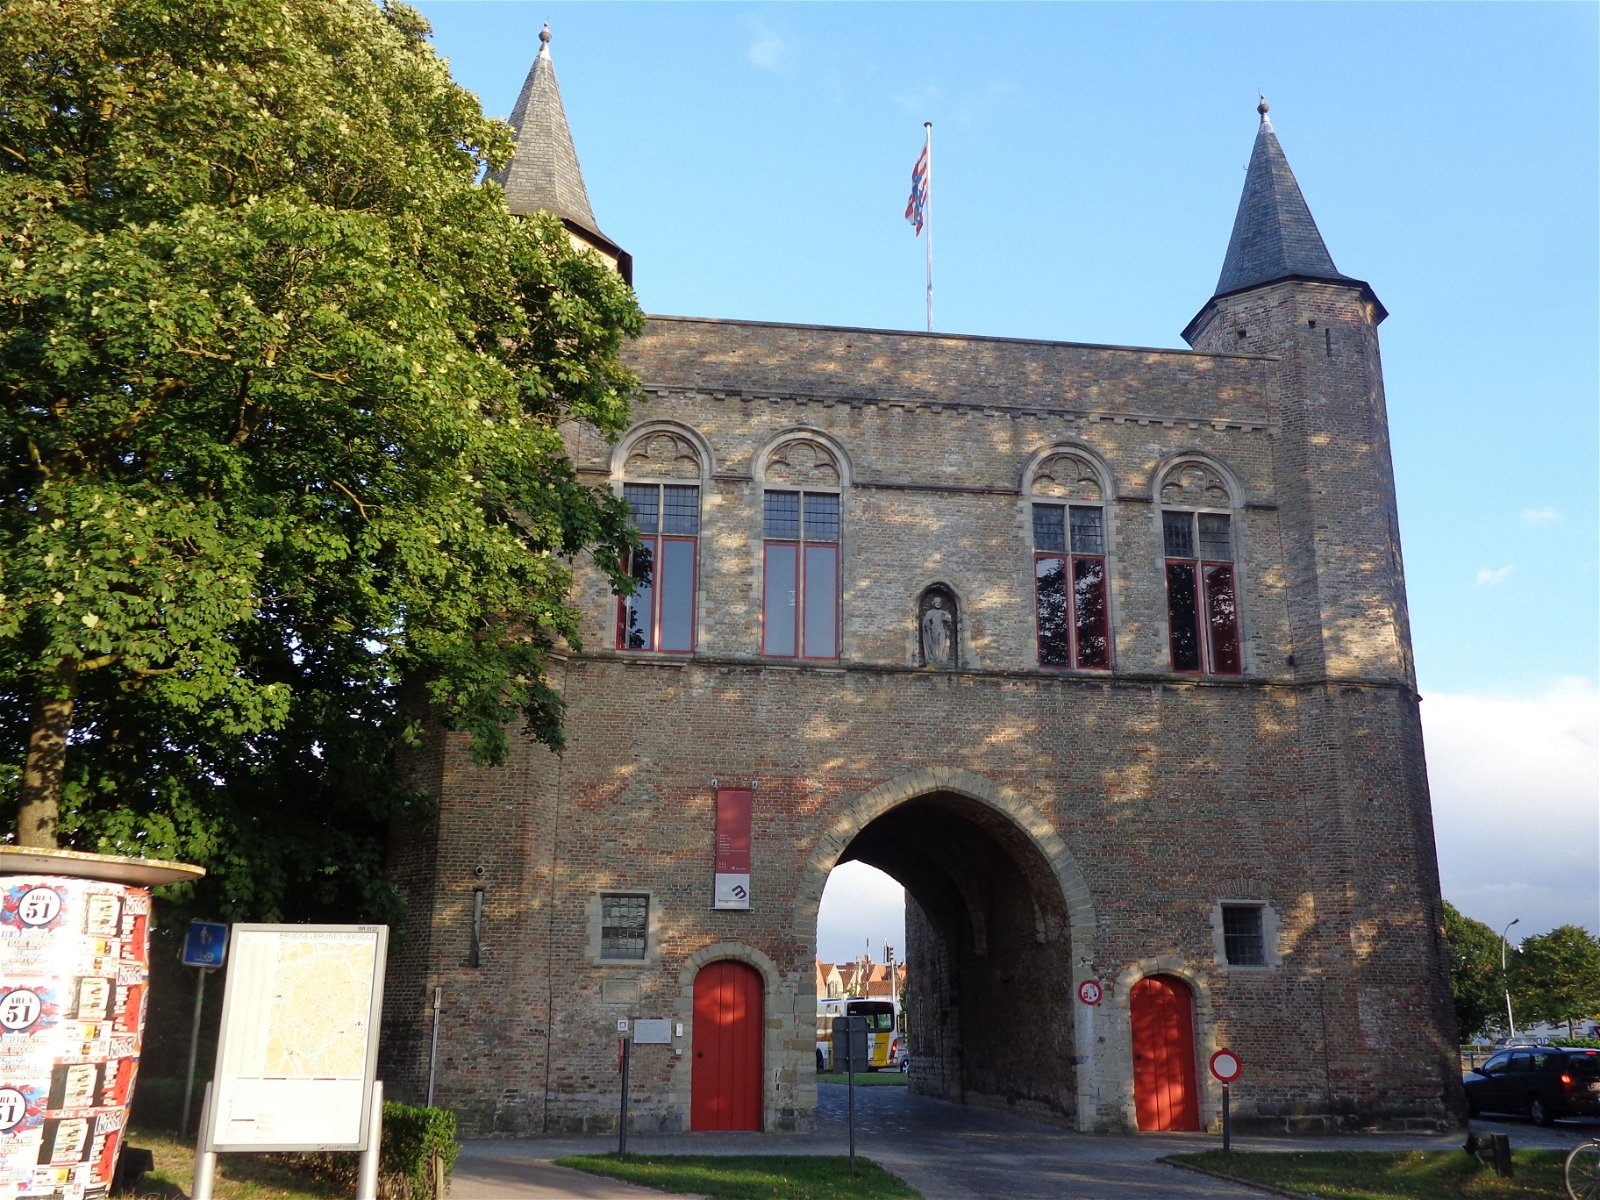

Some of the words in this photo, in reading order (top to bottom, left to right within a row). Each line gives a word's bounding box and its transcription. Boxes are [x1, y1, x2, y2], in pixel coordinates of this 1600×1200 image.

[25, 902, 50, 919] 51
[5, 1005, 31, 1023] 51
[0, 1096, 17, 1104] REA
